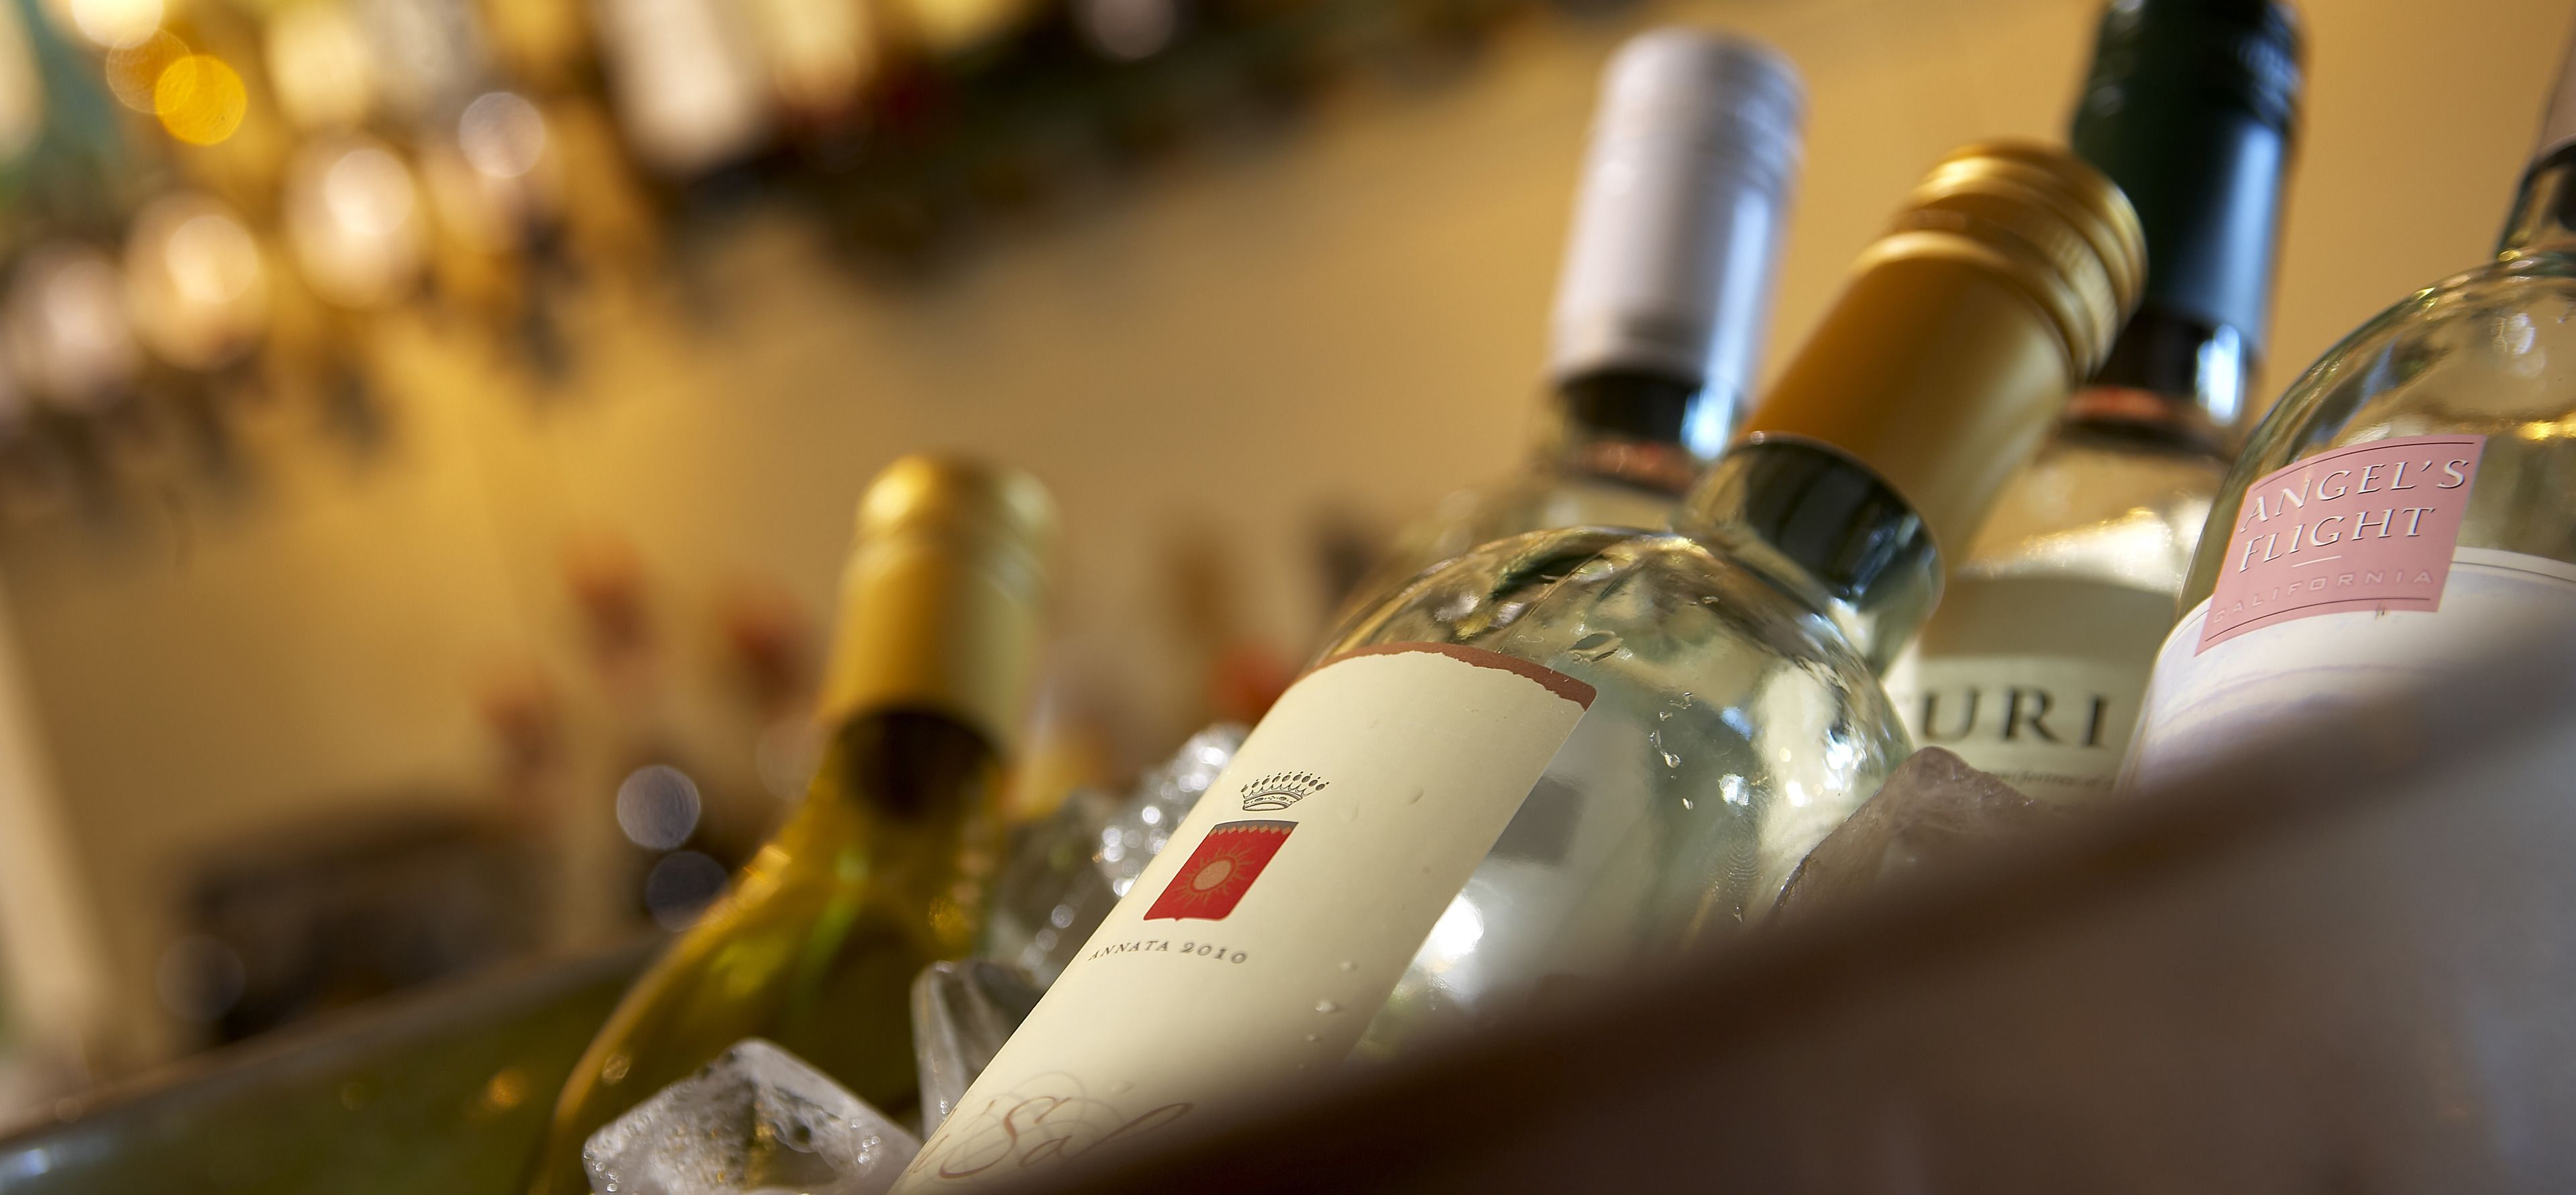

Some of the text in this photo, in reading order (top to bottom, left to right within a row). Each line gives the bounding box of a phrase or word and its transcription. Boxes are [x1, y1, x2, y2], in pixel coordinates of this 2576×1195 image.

[2239, 459, 2469, 534] ANGEL'S
[2238, 506, 2436, 573] FLIGHT
[2212, 571, 2432, 624] CALIFORNIA
[1920, 685, 2113, 749] URI
[1087, 940, 1249, 964] ANNATA 2010
